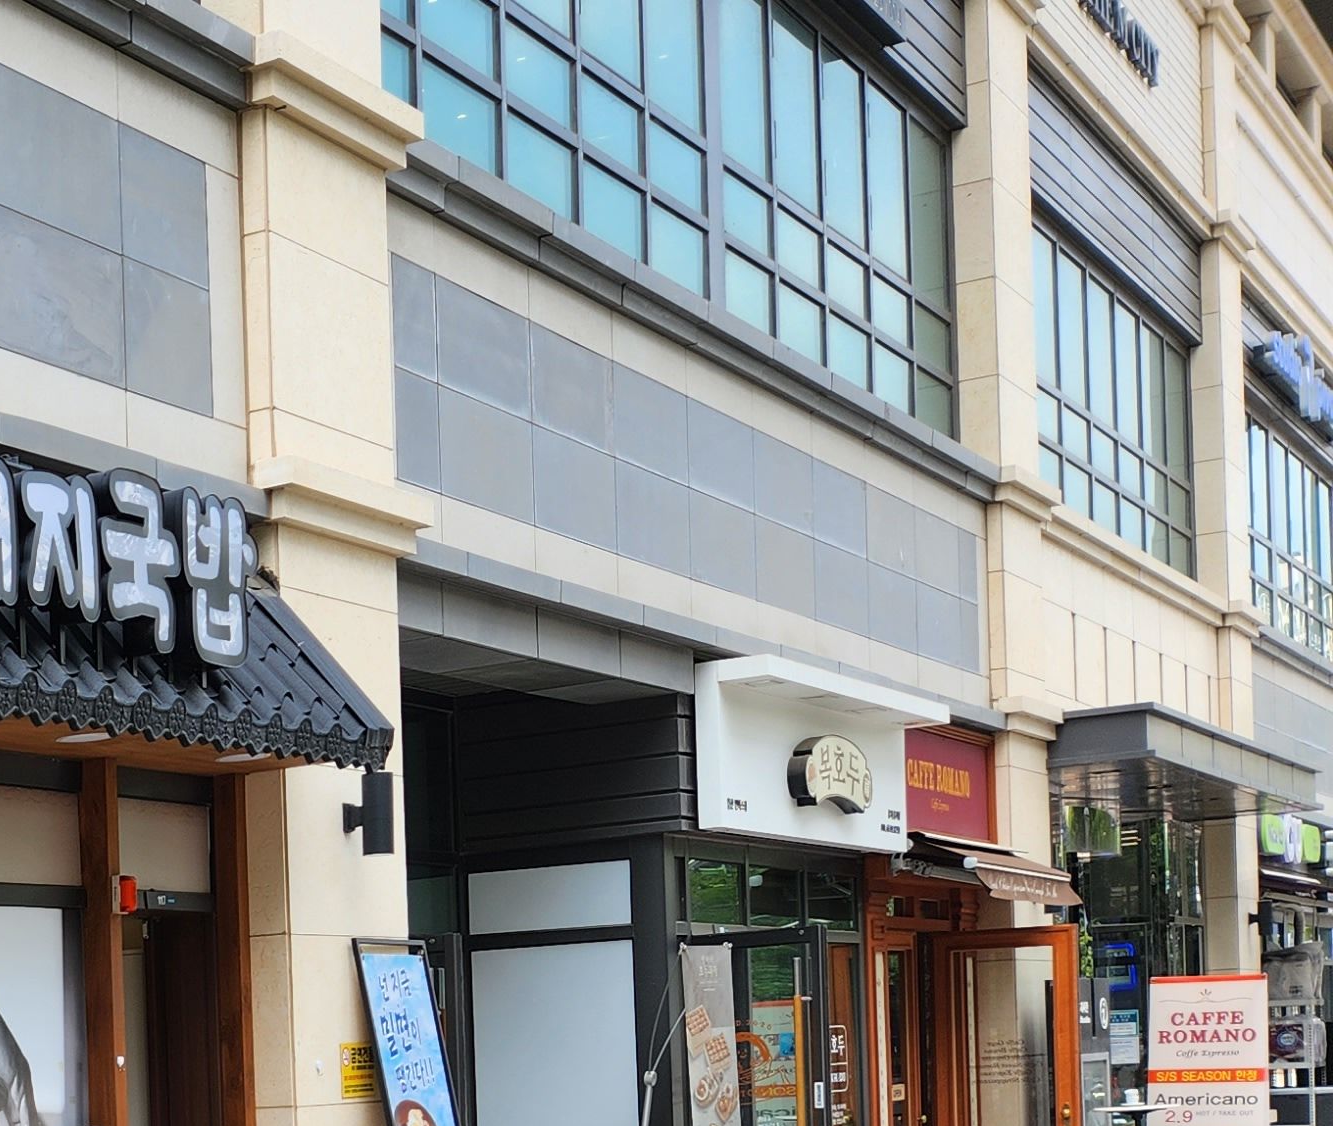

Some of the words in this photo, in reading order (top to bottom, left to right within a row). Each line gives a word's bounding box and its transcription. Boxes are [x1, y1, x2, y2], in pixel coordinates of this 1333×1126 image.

[818, 744, 861, 797] 복호두
[907, 758, 935, 791] CAFFE
[936, 763, 971, 799] ROMANO
[1171, 1011, 1244, 1027] CAFFE
[1158, 1028, 1257, 1045] ROMANO
[1156, 1071, 1177, 1082] S/S
[1181, 1070, 1231, 1082] SEASON
[1154, 1093, 1259, 1106] Americano
[1164, 1110, 1193, 1124] 2.9
